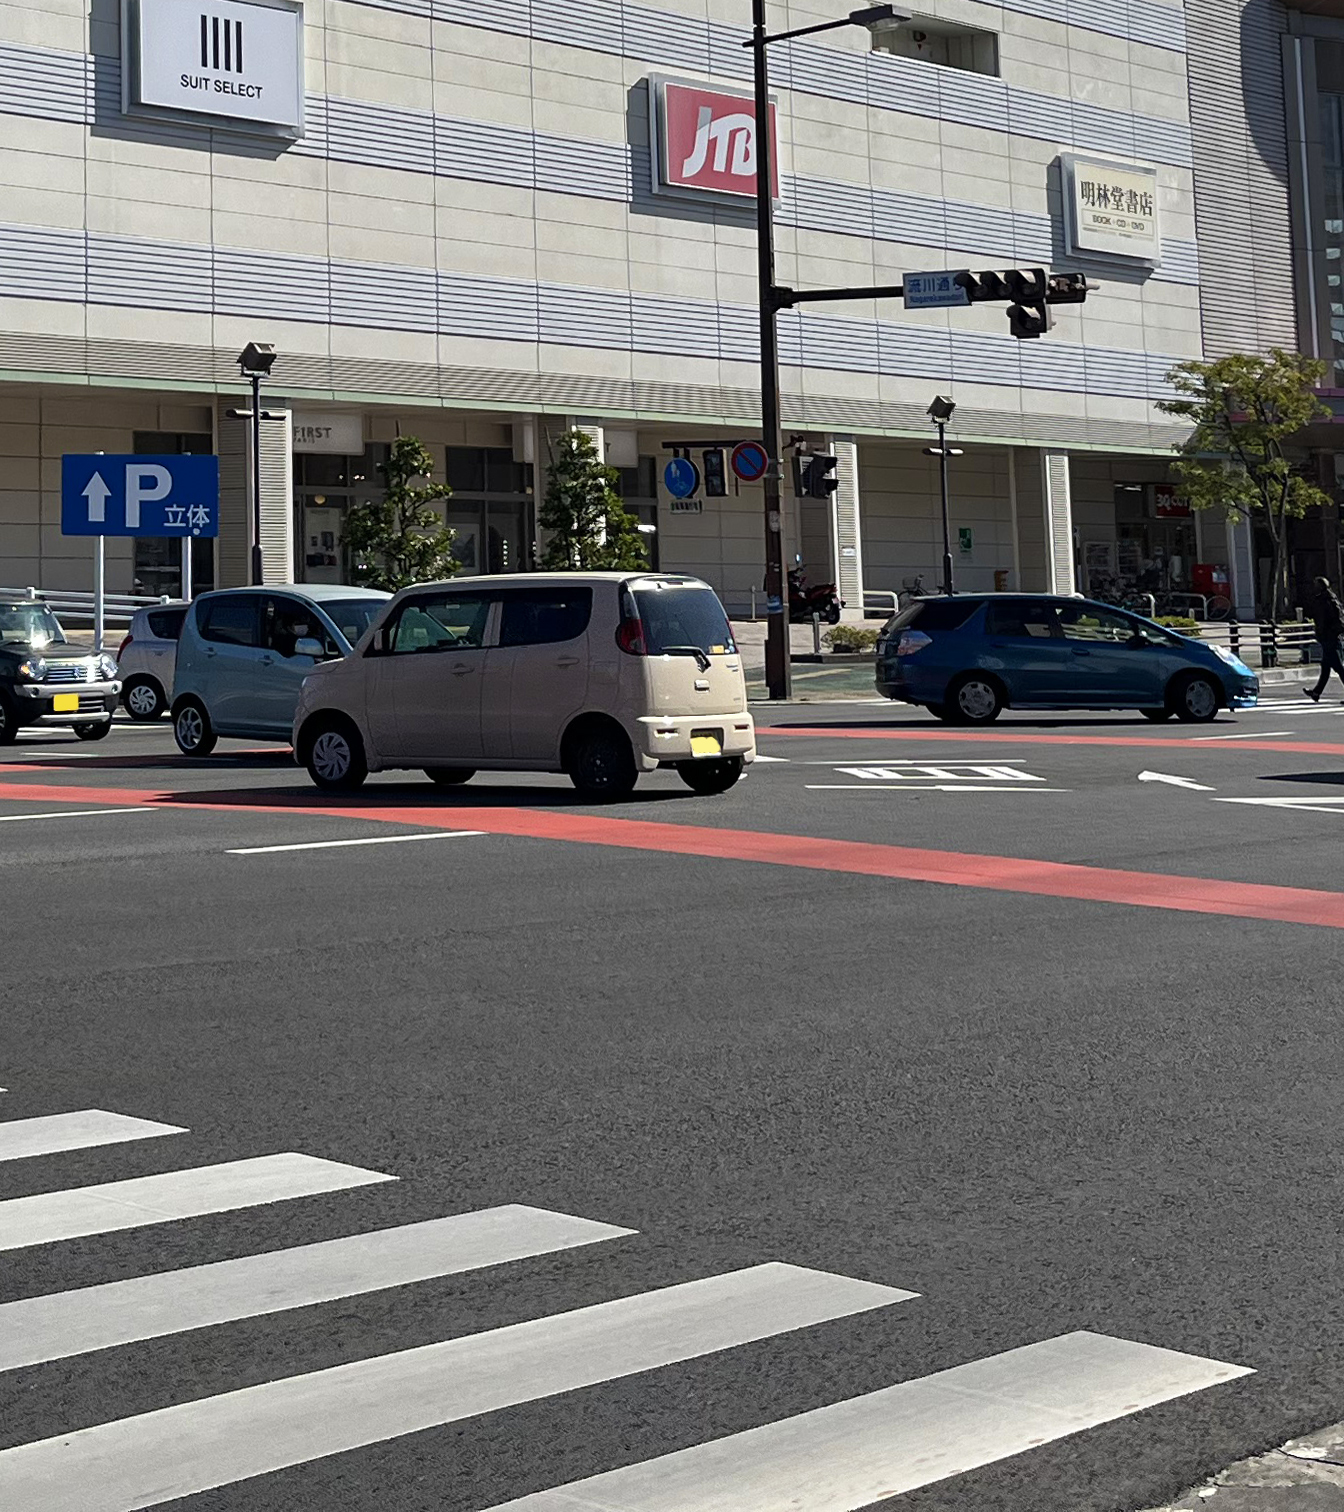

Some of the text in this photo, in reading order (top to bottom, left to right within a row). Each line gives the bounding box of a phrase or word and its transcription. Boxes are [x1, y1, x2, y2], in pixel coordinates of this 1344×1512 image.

[180, 74, 264, 99] SUIT SELECT
[681, 105, 757, 179] JTB
[1080, 180, 1153, 217] 明林堂書店
[1092, 214, 1145, 232] BOOK CD DVD
[125, 463, 173, 528] P
[163, 503, 210, 528] 立体
